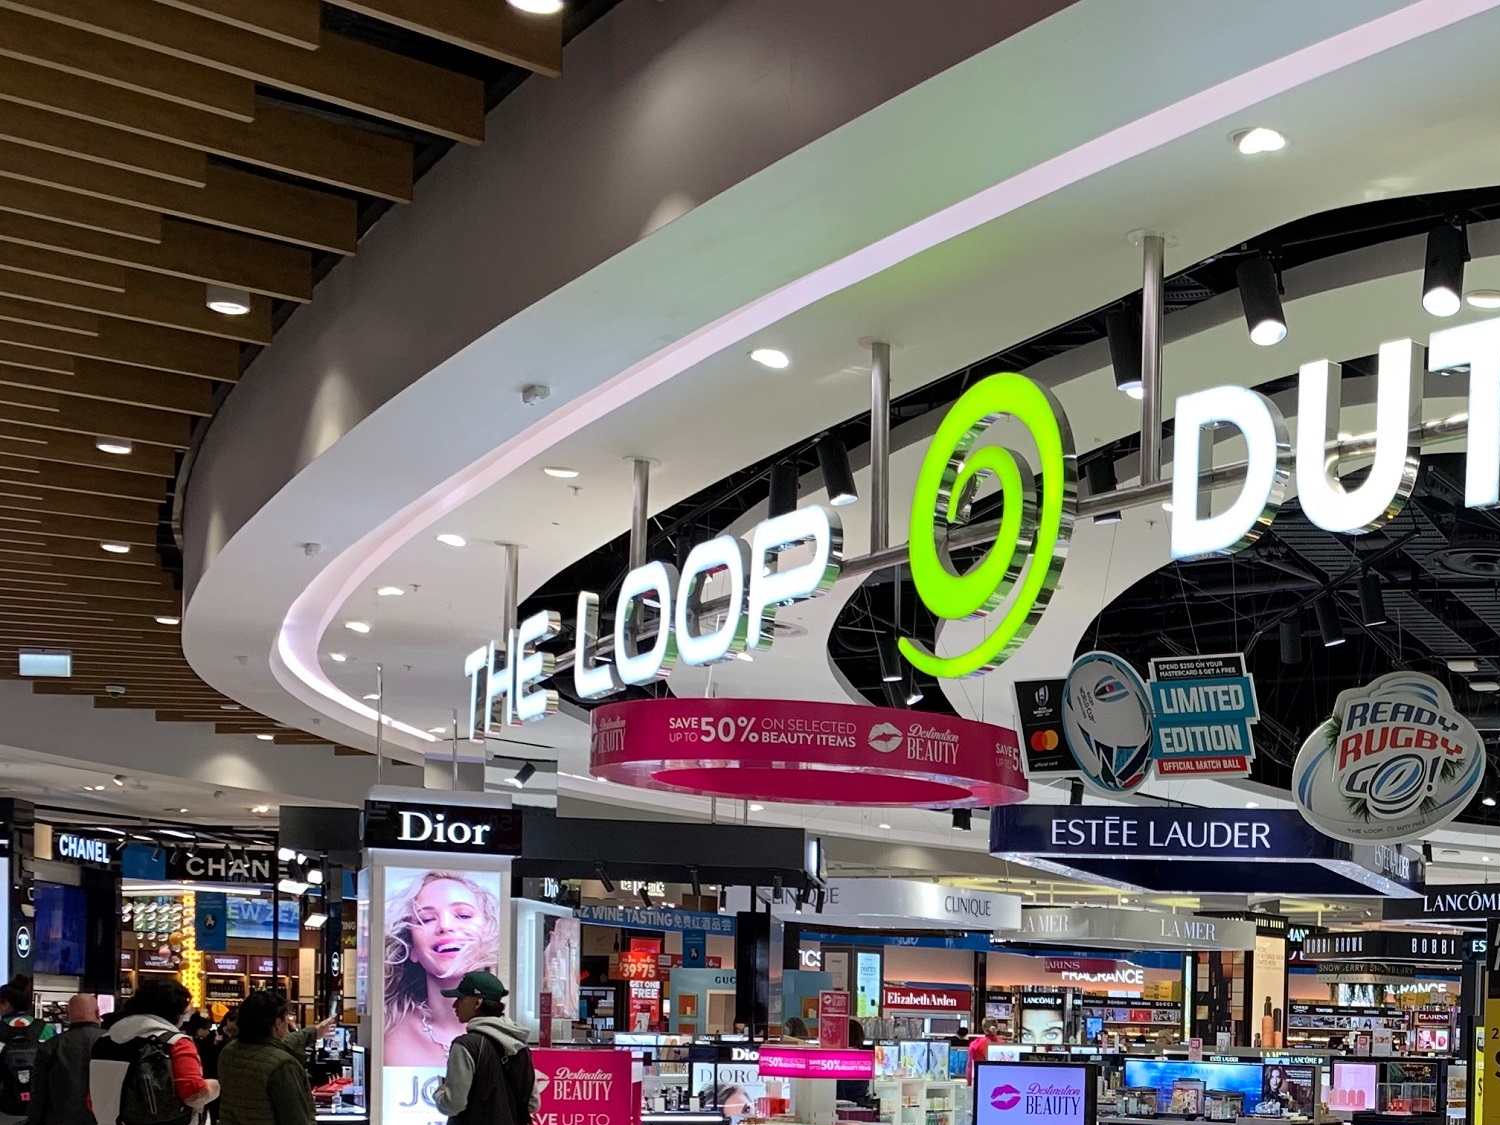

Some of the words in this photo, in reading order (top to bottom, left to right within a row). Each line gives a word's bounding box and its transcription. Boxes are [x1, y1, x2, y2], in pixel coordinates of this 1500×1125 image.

[464, 610, 560, 743] THE
[574, 505, 838, 699] LOOP
[1160, 685, 1244, 714] LIMITED
[1346, 702, 1459, 732] READY
[669, 717, 698, 729] SAVE
[700, 717, 759, 743] 50%
[761, 718, 784, 730] ON
[788, 720, 856, 734] SELECTED
[669, 732, 683, 743] UP
[685, 732, 698, 743] TO
[761, 732, 814, 745] BEAUTY
[817, 735, 856, 748] ITEMS
[907, 723, 960, 743] Destination
[1159, 724, 1242, 753] EDITION
[907, 739, 960, 764] BEAUTY
[1339, 727, 1463, 771] RUGBY
[1163, 760, 1195, 771] OFFICIAL
[1196, 760, 1222, 770] MATCH
[1224, 759, 1240, 769] BALL
[1346, 754, 1441, 805] GO!
[397, 811, 490, 845] Dior
[1149, 821, 1271, 848] LAUDER
[59, 833, 112, 864] CHANEL
[592, 907, 624, 922] WINE
[625, 908, 673, 927] TASTING
[945, 895, 991, 917] CLINIQUE
[1161, 919, 1181, 938] LA
[1185, 922, 1218, 941] MER
[1306, 938, 1330, 953] BOBBI
[1335, 937, 1363, 952] BROWN
[1491, 1028, 1499, 1040] 2
[553, 1066, 613, 1081] Destination
[553, 1081, 613, 1100] BEAUTY
[1026, 1083, 1081, 1095] Destination
[1025, 1096, 1081, 1115] BEAUTY
